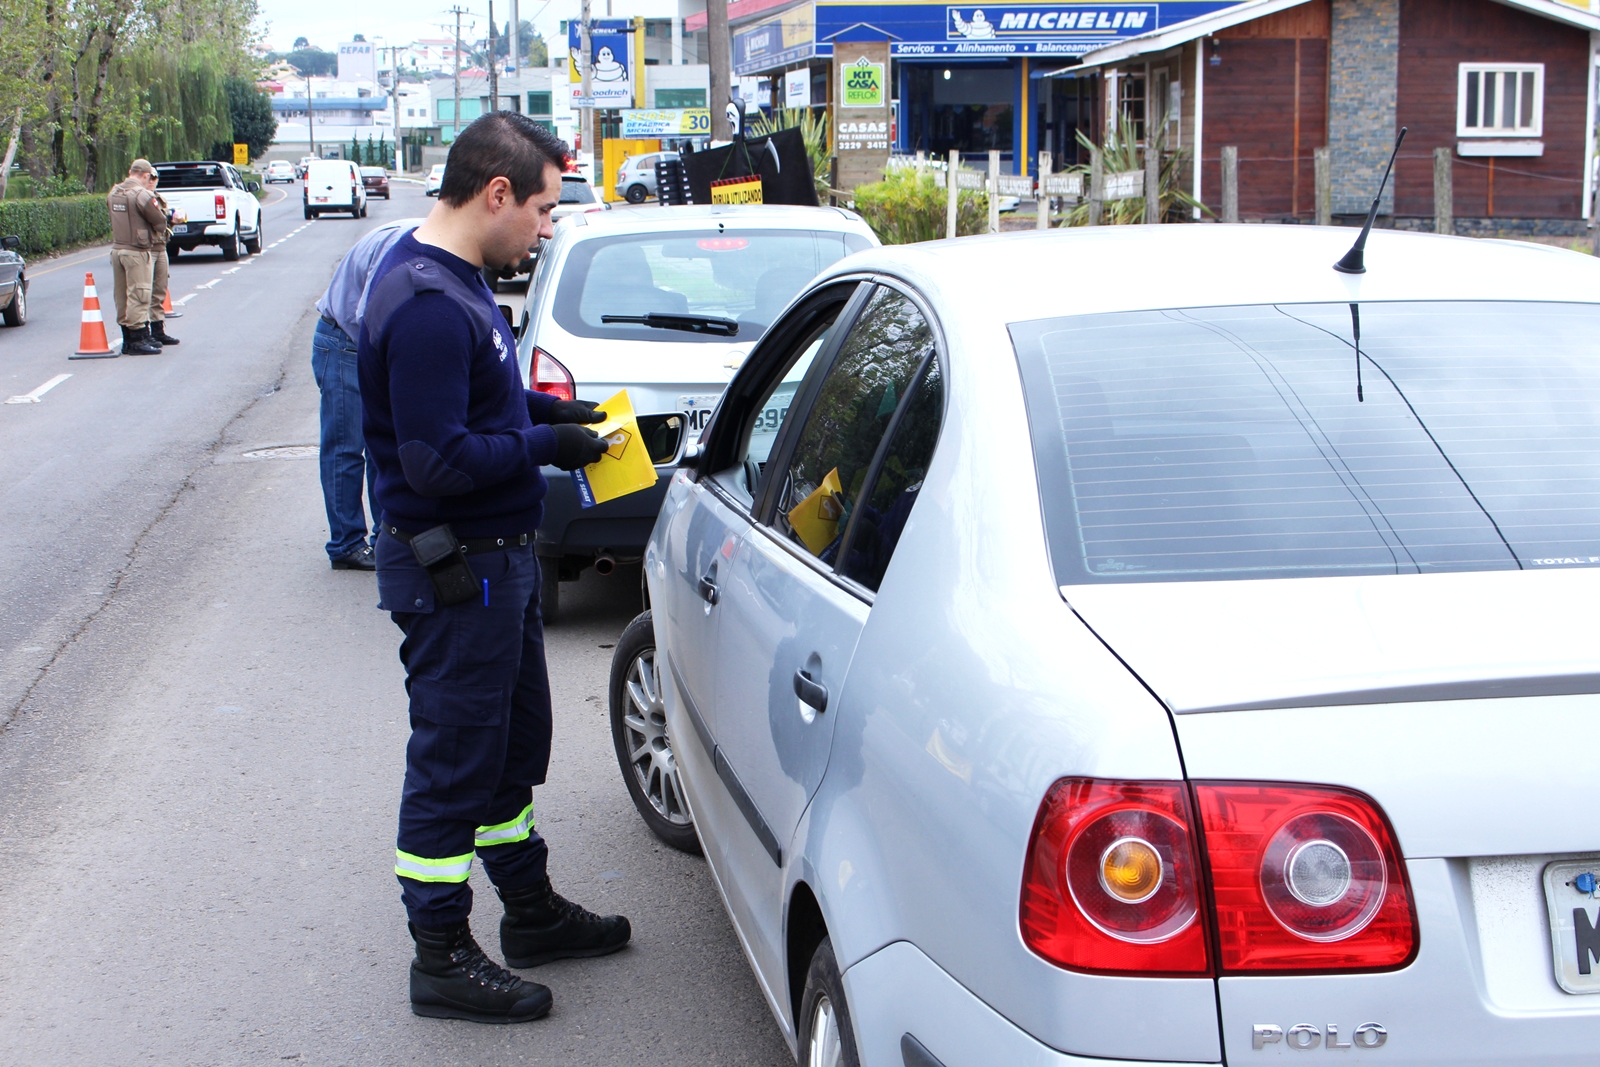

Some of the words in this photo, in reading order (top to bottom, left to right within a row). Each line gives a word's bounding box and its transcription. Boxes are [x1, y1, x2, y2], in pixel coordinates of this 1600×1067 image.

[1000, 11, 1148, 30] MICHELIN
[897, 43, 935, 54] Serviços
[955, 43, 1016, 53] Alinhamento
[1036, 43, 1103, 53] Balanceament
[853, 71, 873, 79] KIT
[847, 80, 878, 89] CASA
[848, 91, 877, 100] REFLOR
[628, 110, 676, 121] FEIRÃO
[689, 115, 709, 130] 30
[838, 123, 887, 133] CASAS
[838, 142, 861, 150] 3229
[867, 141, 887, 149] 3412
[1046, 178, 1080, 194] AUTOCLAVE
[730, 188, 761, 204] UTILIZANDO
[684, 409, 711, 430] MG
[574, 468, 584, 482] EST
[1533, 557, 1585, 565] TOTAL
[1252, 1021, 1388, 1050] POLO
